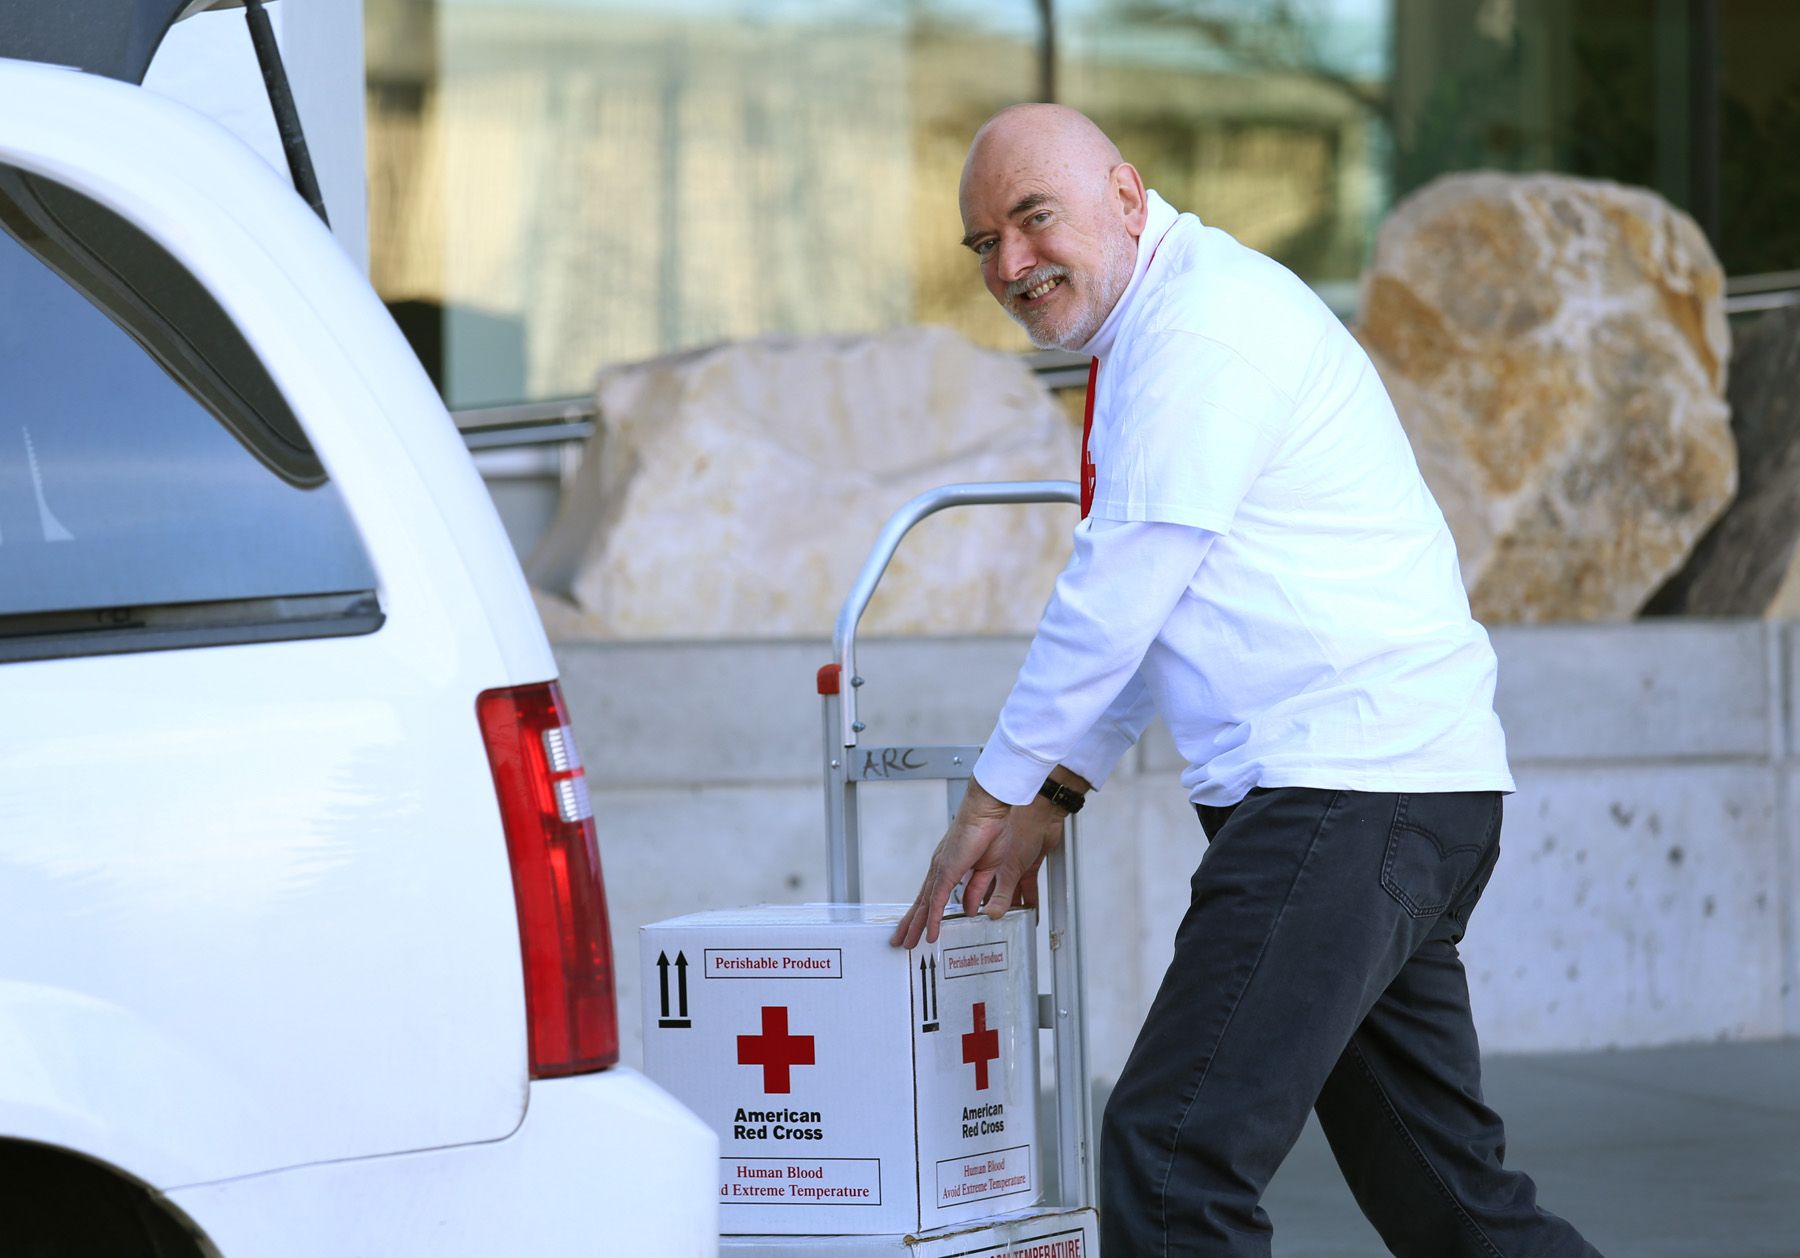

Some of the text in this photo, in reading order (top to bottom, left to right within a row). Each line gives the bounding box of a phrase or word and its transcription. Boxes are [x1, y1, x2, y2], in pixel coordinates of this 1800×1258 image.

[863, 748, 928, 778] ARC
[715, 957, 831, 969] Perishable Product
[948, 954, 980, 969] Perishable
[734, 1108, 822, 1123] American
[962, 1103, 1004, 1122] American
[734, 1125, 823, 1140] Red Cross
[962, 1120, 1005, 1139] Red Cross
[736, 1166, 823, 1179] Human Blood
[964, 1158, 1005, 1177] Human Blood
[732, 1184, 785, 1196] Extreme
[788, 1184, 870, 1199] Temperature
[942, 1175, 1026, 1200] Avoid Extreme Temperature
